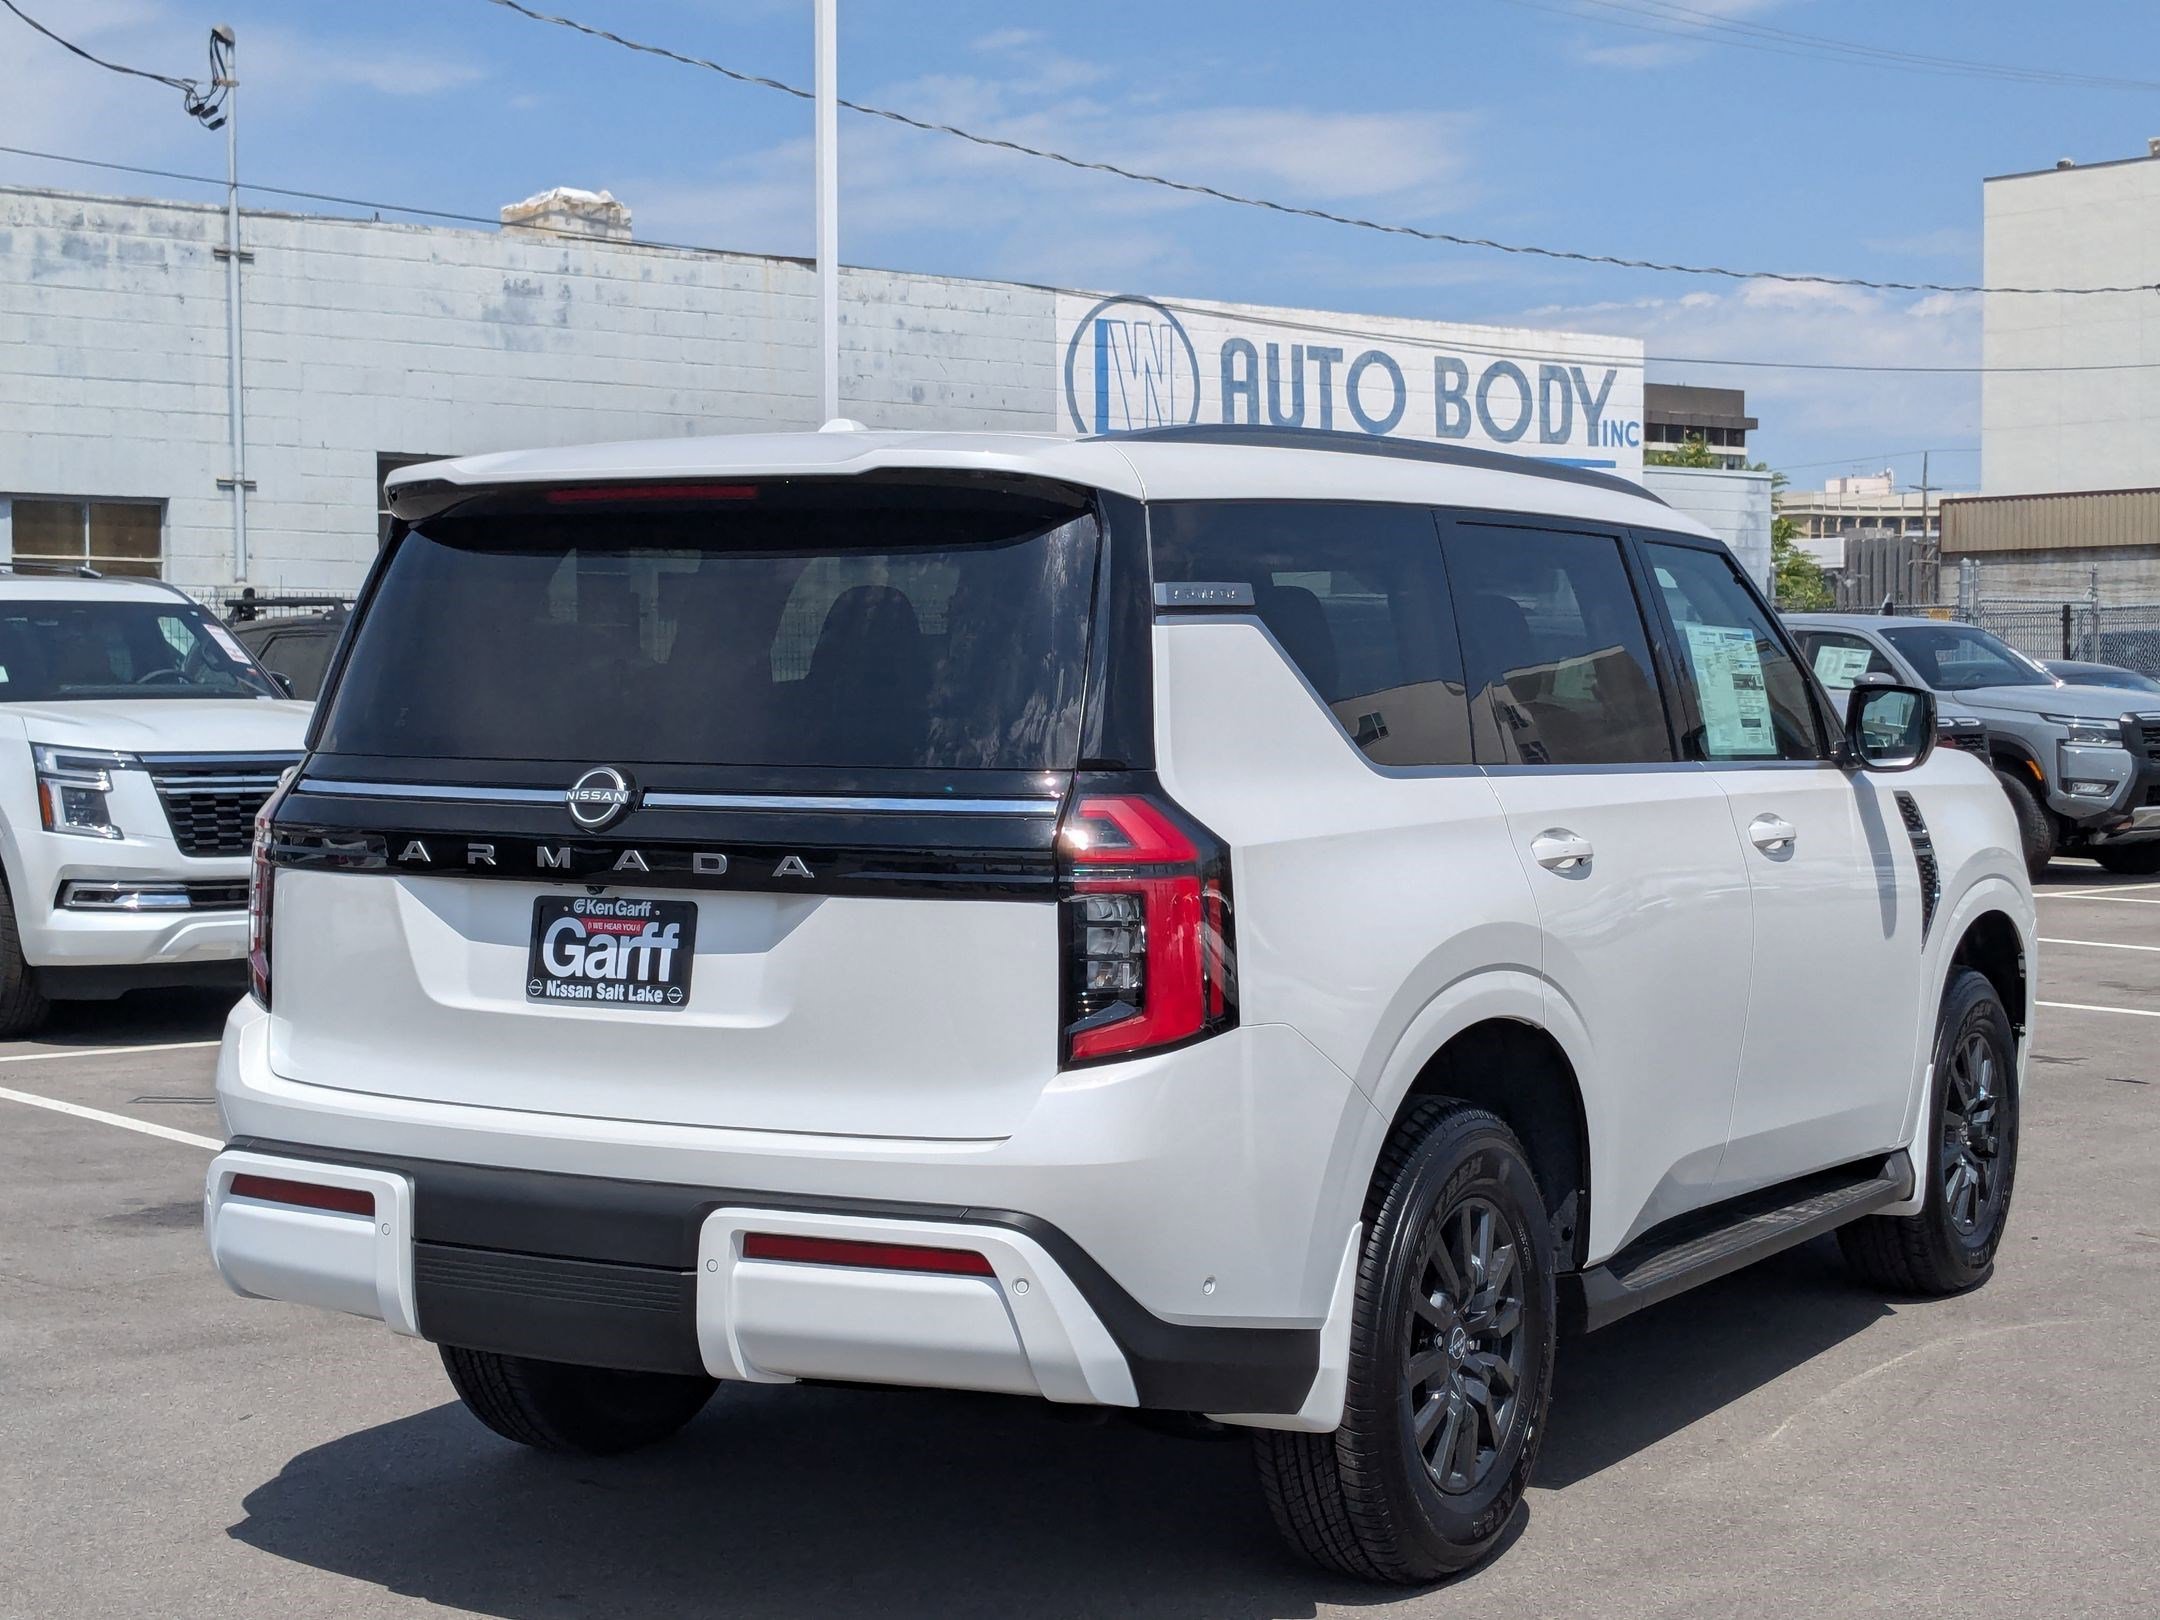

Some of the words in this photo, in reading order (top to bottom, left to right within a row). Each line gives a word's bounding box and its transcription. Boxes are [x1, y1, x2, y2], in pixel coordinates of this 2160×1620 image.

[1220, 337, 1407, 436] AUTO
[1434, 356, 1618, 448] BODY
[1602, 420, 1640, 448] INC
[565, 790, 627, 803] NISSAN
[397, 840, 815, 879] ARMADA
[585, 899, 614, 915] Ken
[615, 900, 652, 917] Garff
[592, 922, 603, 930] WE
[603, 922, 622, 931] HEAR
[622, 923, 637, 932] YOU
[542, 916, 680, 983] Garff
[546, 980, 593, 999] Nissan
[596, 982, 625, 1001] Salt
[628, 984, 663, 1003] Lake
